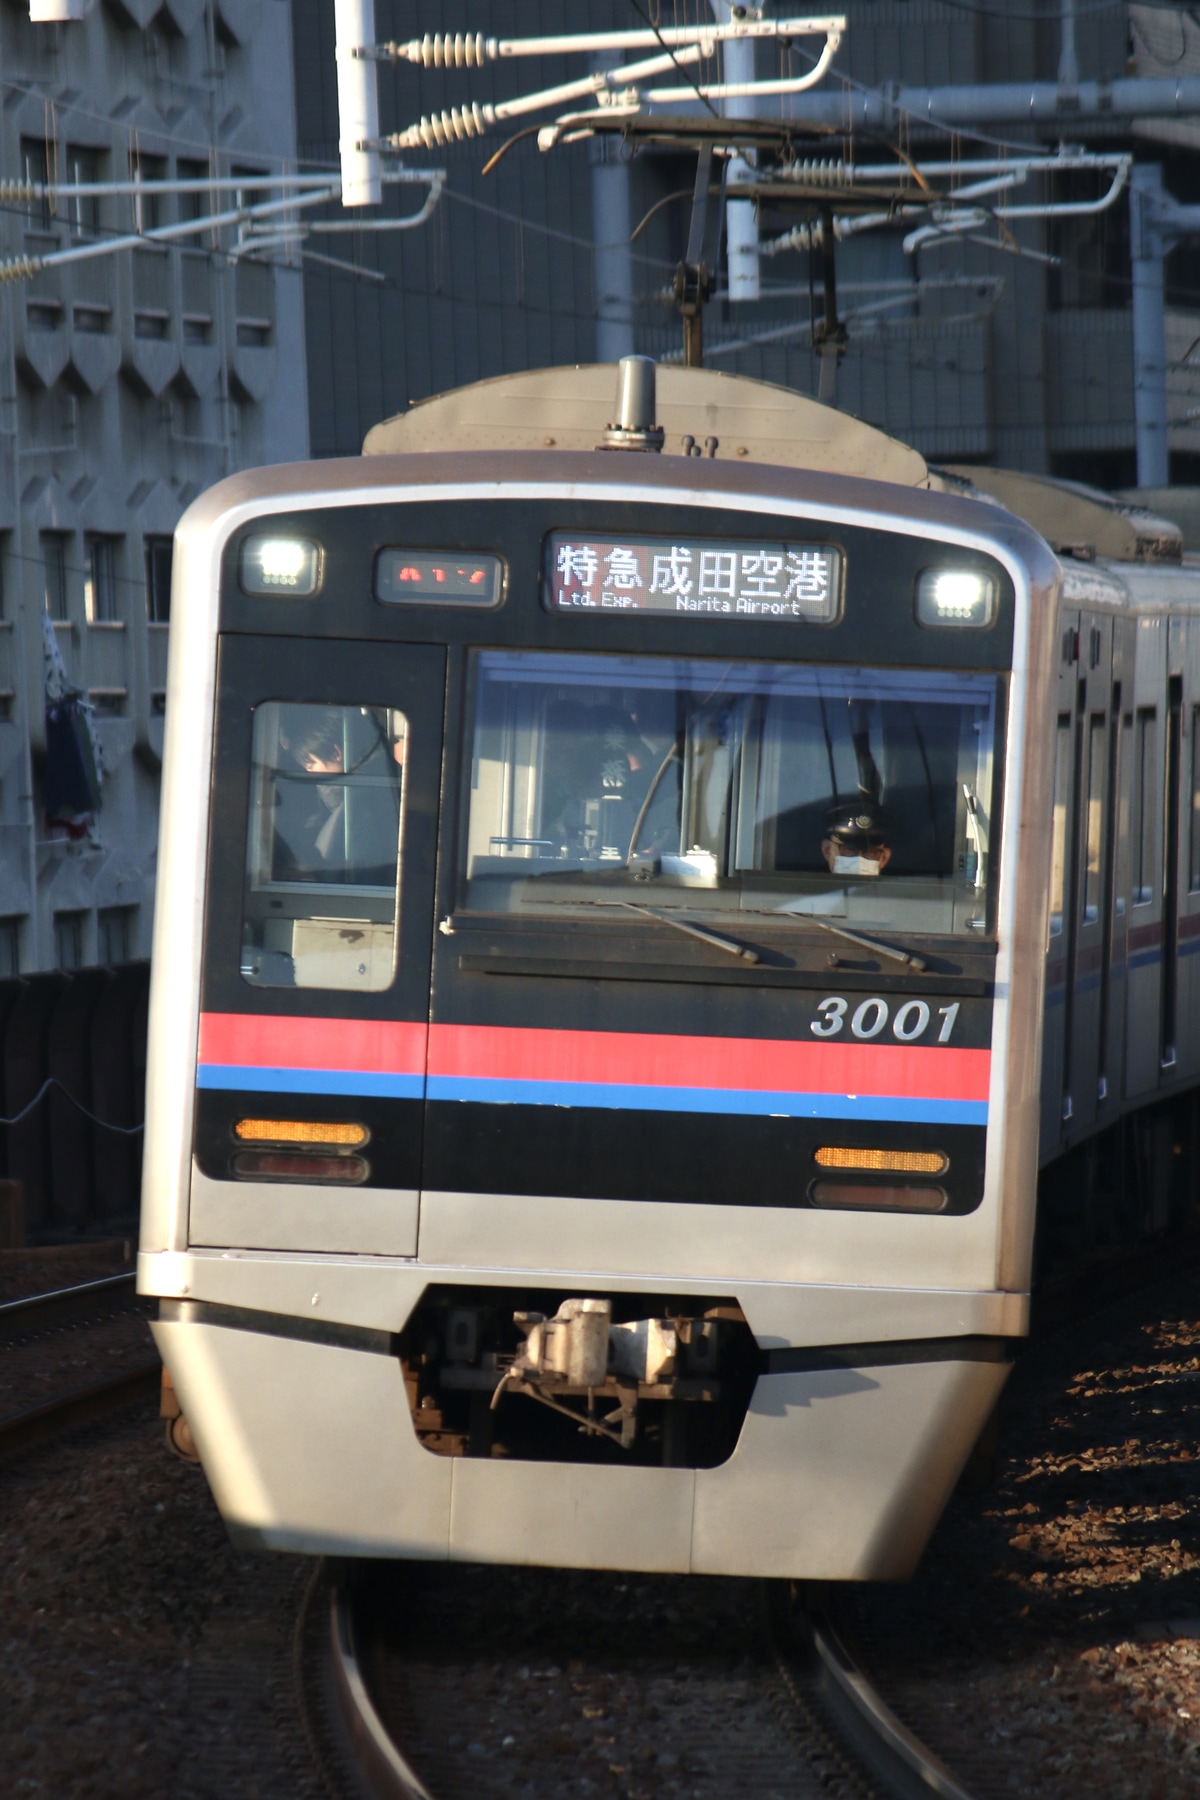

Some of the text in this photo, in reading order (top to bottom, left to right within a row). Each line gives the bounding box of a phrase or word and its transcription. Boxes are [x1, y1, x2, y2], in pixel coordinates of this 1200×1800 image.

[557, 545, 831, 601] 特急 成田空港
[558, 589, 639, 609] Ltd. Exp.
[675, 594, 800, 616] Narita Airport
[810, 996, 961, 1043] 3001
